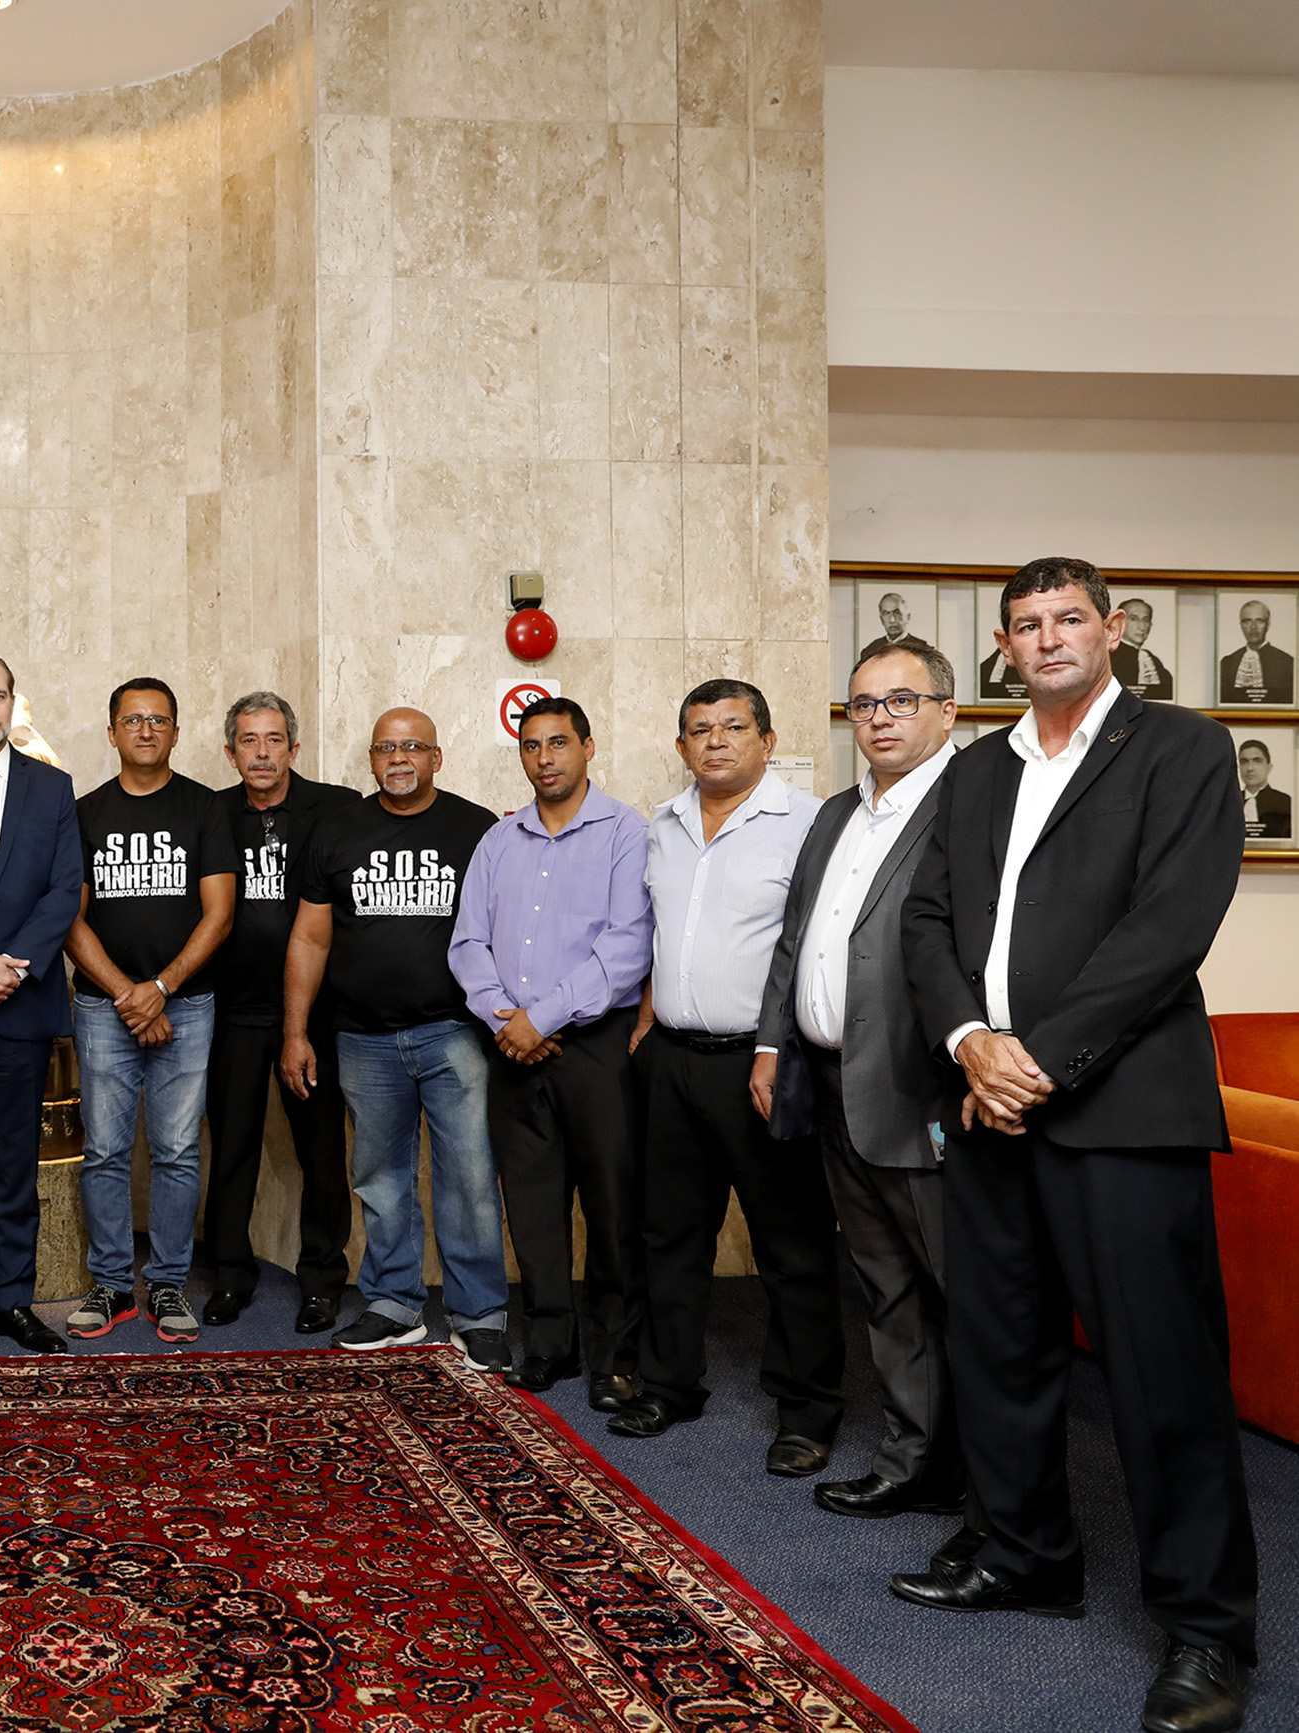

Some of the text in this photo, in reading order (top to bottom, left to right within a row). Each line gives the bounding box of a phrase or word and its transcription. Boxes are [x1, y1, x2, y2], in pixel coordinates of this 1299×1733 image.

[106, 831, 171, 865] S.O.S
[93, 863, 187, 890] PINHEIRO
[369, 849, 439, 882] S.O.S
[136, 888, 149, 897] SOU
[351, 880, 456, 908] PINHEIRO
[401, 906, 414, 914] SOU
